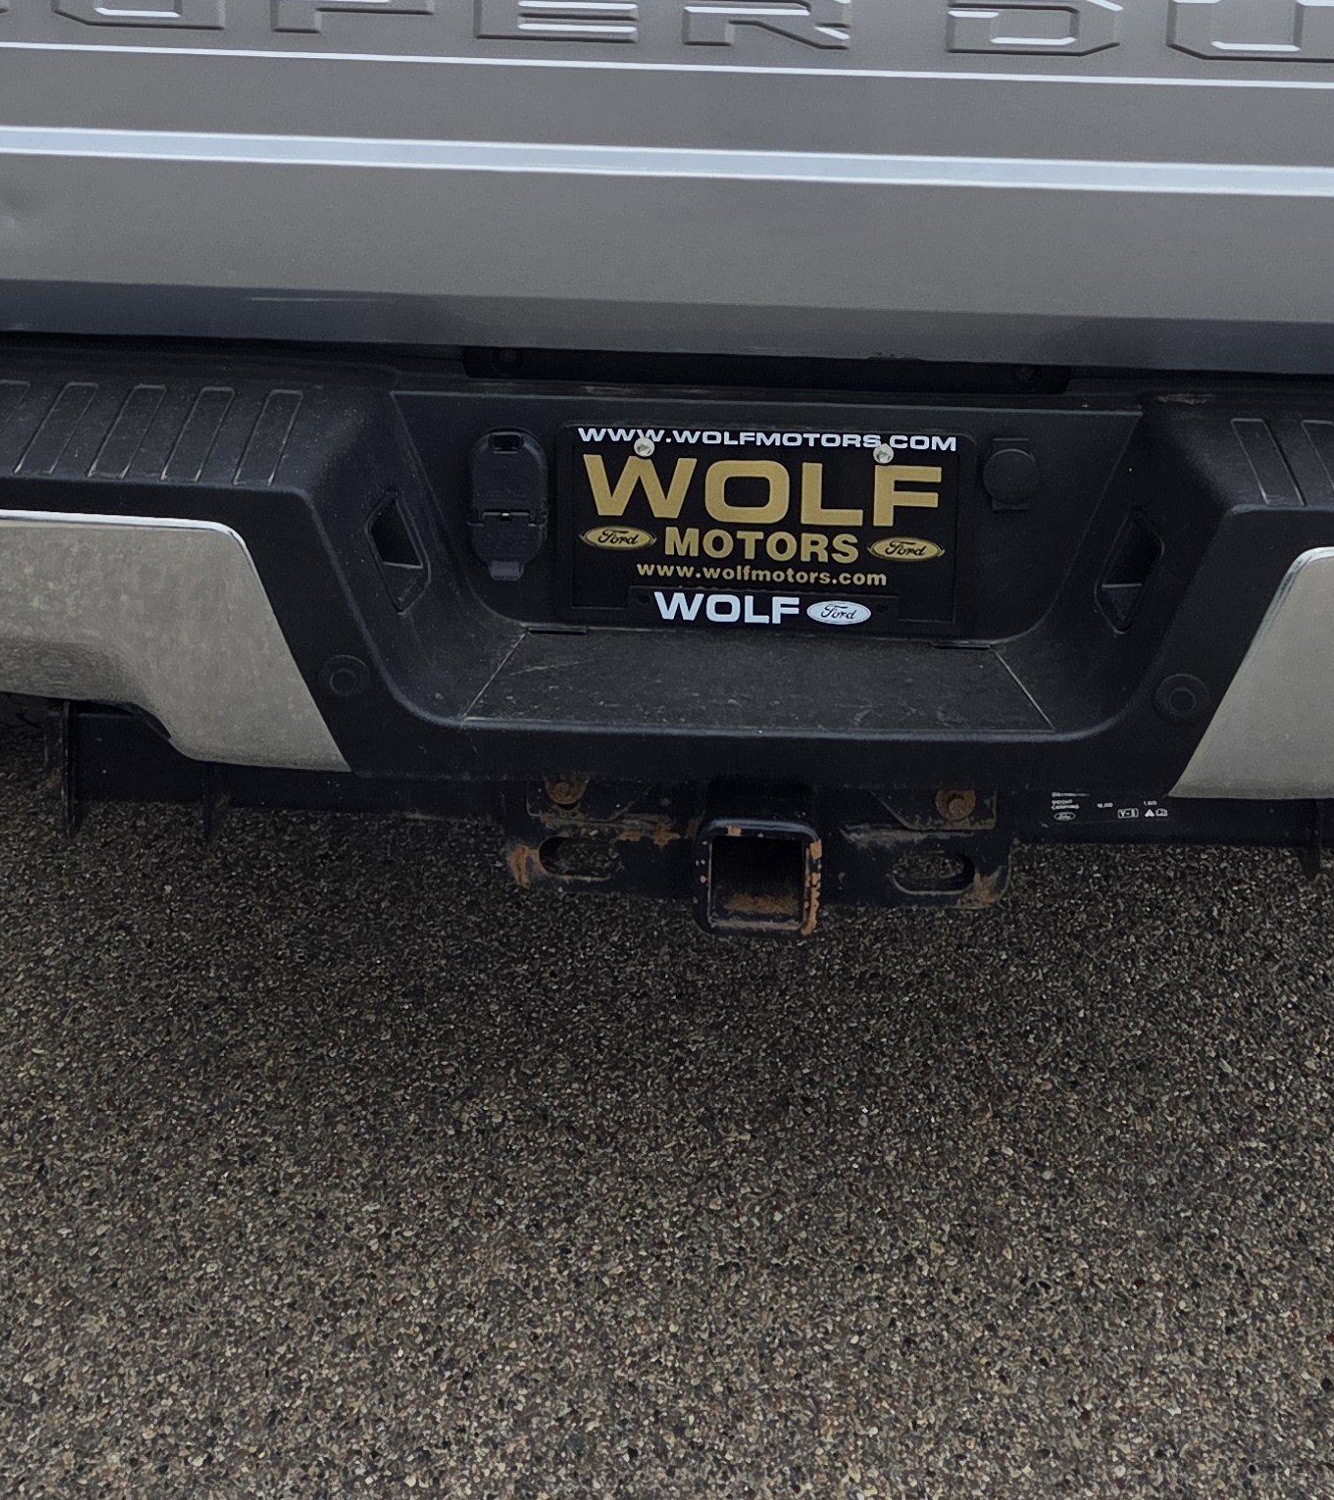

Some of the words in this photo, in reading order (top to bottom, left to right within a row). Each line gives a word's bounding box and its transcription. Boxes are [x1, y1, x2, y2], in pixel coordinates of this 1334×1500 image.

[578, 427, 957, 452] WWW.WOLFMOTORSCOM
[583, 454, 942, 527] WOLF
[597, 528, 639, 545] Ford
[665, 526, 859, 564] MOTORS
[884, 540, 927, 557] Ford
[636, 563, 887, 586] www.wolfmotors.com
[654, 591, 800, 624] WOLF
[820, 603, 857, 620] Ford
